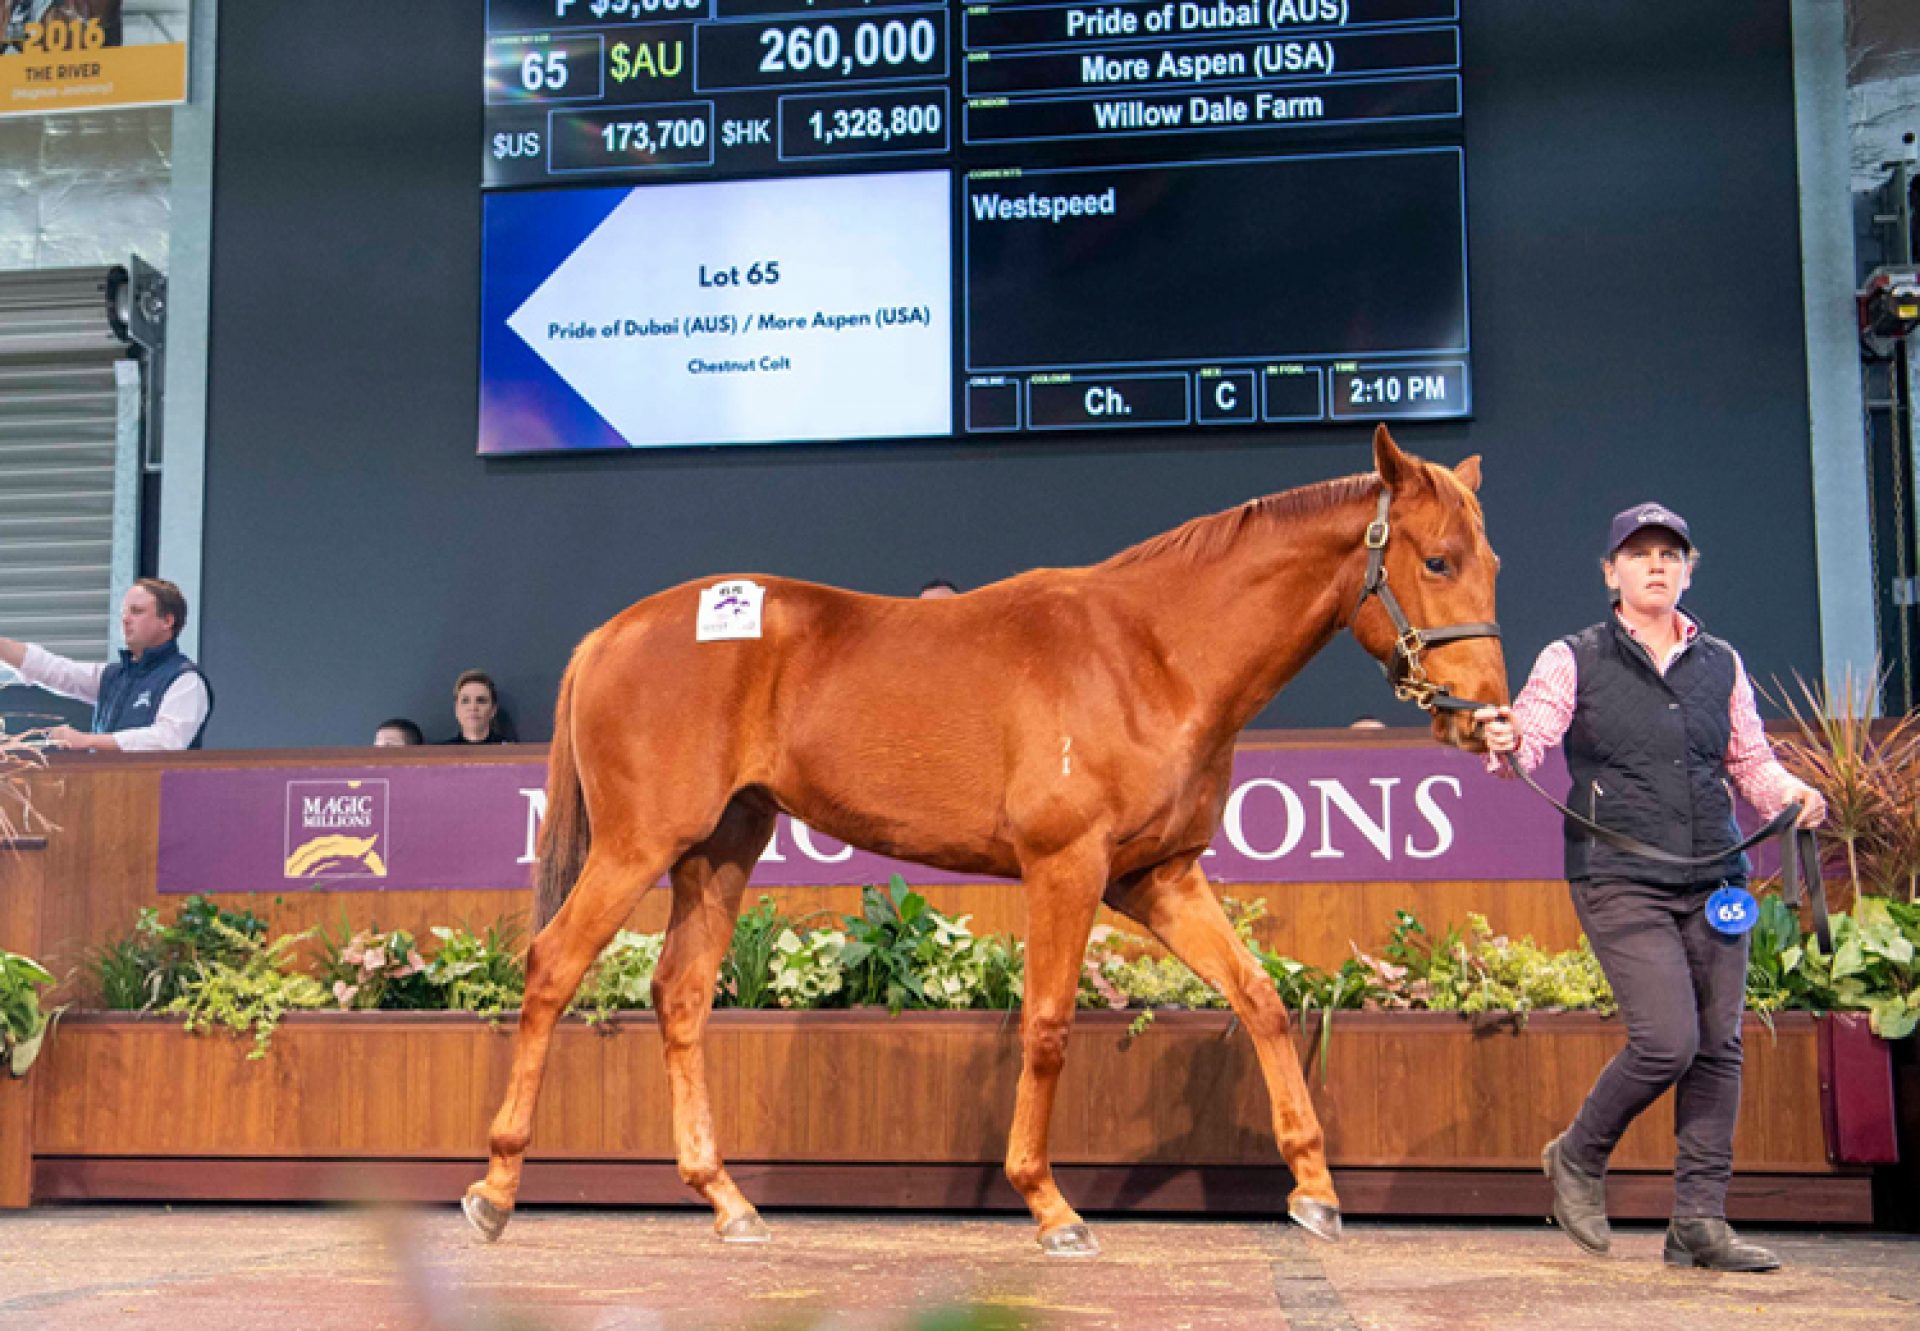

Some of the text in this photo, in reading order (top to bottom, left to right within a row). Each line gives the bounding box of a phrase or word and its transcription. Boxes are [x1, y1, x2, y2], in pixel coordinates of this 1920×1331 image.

[24, 18, 105, 51] 2016
[1067, 0, 1348, 37] Pride of Dubai (AUS)
[759, 19, 935, 75] 260,000
[1082, 41, 1335, 83] More Aspen (USA)
[26, 63, 101, 81] THE RIVER
[521, 40, 683, 91] 65 $AU
[809, 104, 941, 144] 1,328,800
[1094, 93, 1323, 129] Willow Dale Farm
[493, 132, 541, 159] $US
[602, 118, 706, 155] 173,700
[721, 118, 771, 146] $HK
[972, 187, 1116, 223] Westspeed
[698, 260, 780, 288] Lot 65
[547, 305, 931, 340] Pride of Dubai (AUS) / More Aspen (USA)
[687, 354, 791, 375] Chestnut Colt
[1084, 386, 1132, 416] Ch.
[1214, 380, 1237, 411] C
[1350, 375, 1446, 403] 2:10 PM
[303, 796, 372, 815] MAGIC
[1718, 903, 1746, 921] 65
